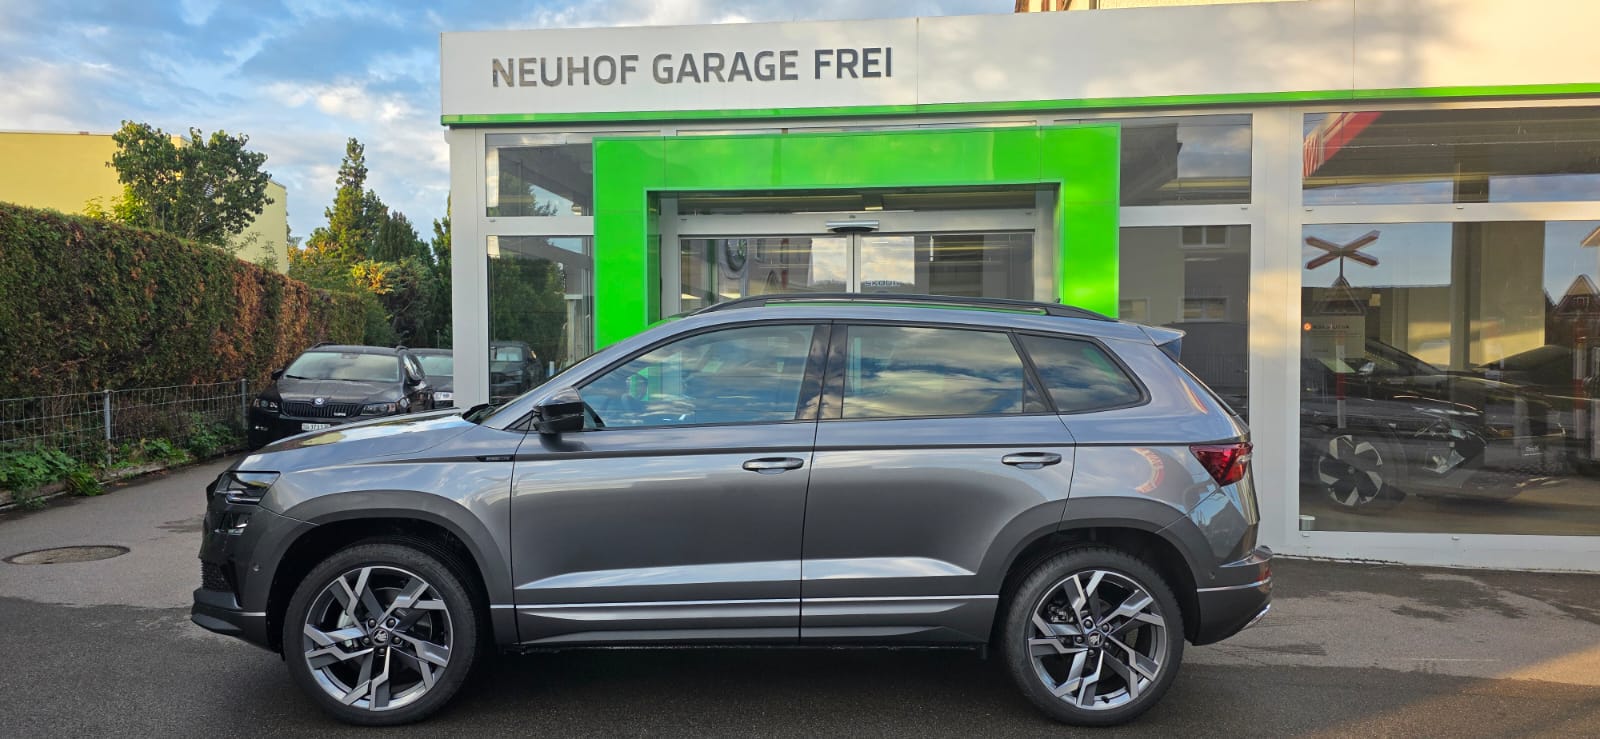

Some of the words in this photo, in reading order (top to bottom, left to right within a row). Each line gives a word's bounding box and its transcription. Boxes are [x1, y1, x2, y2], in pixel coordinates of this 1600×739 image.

[493, 55, 638, 87] NEUHOF
[653, 50, 798, 84] GARAGE
[815, 47, 891, 79] FREI
